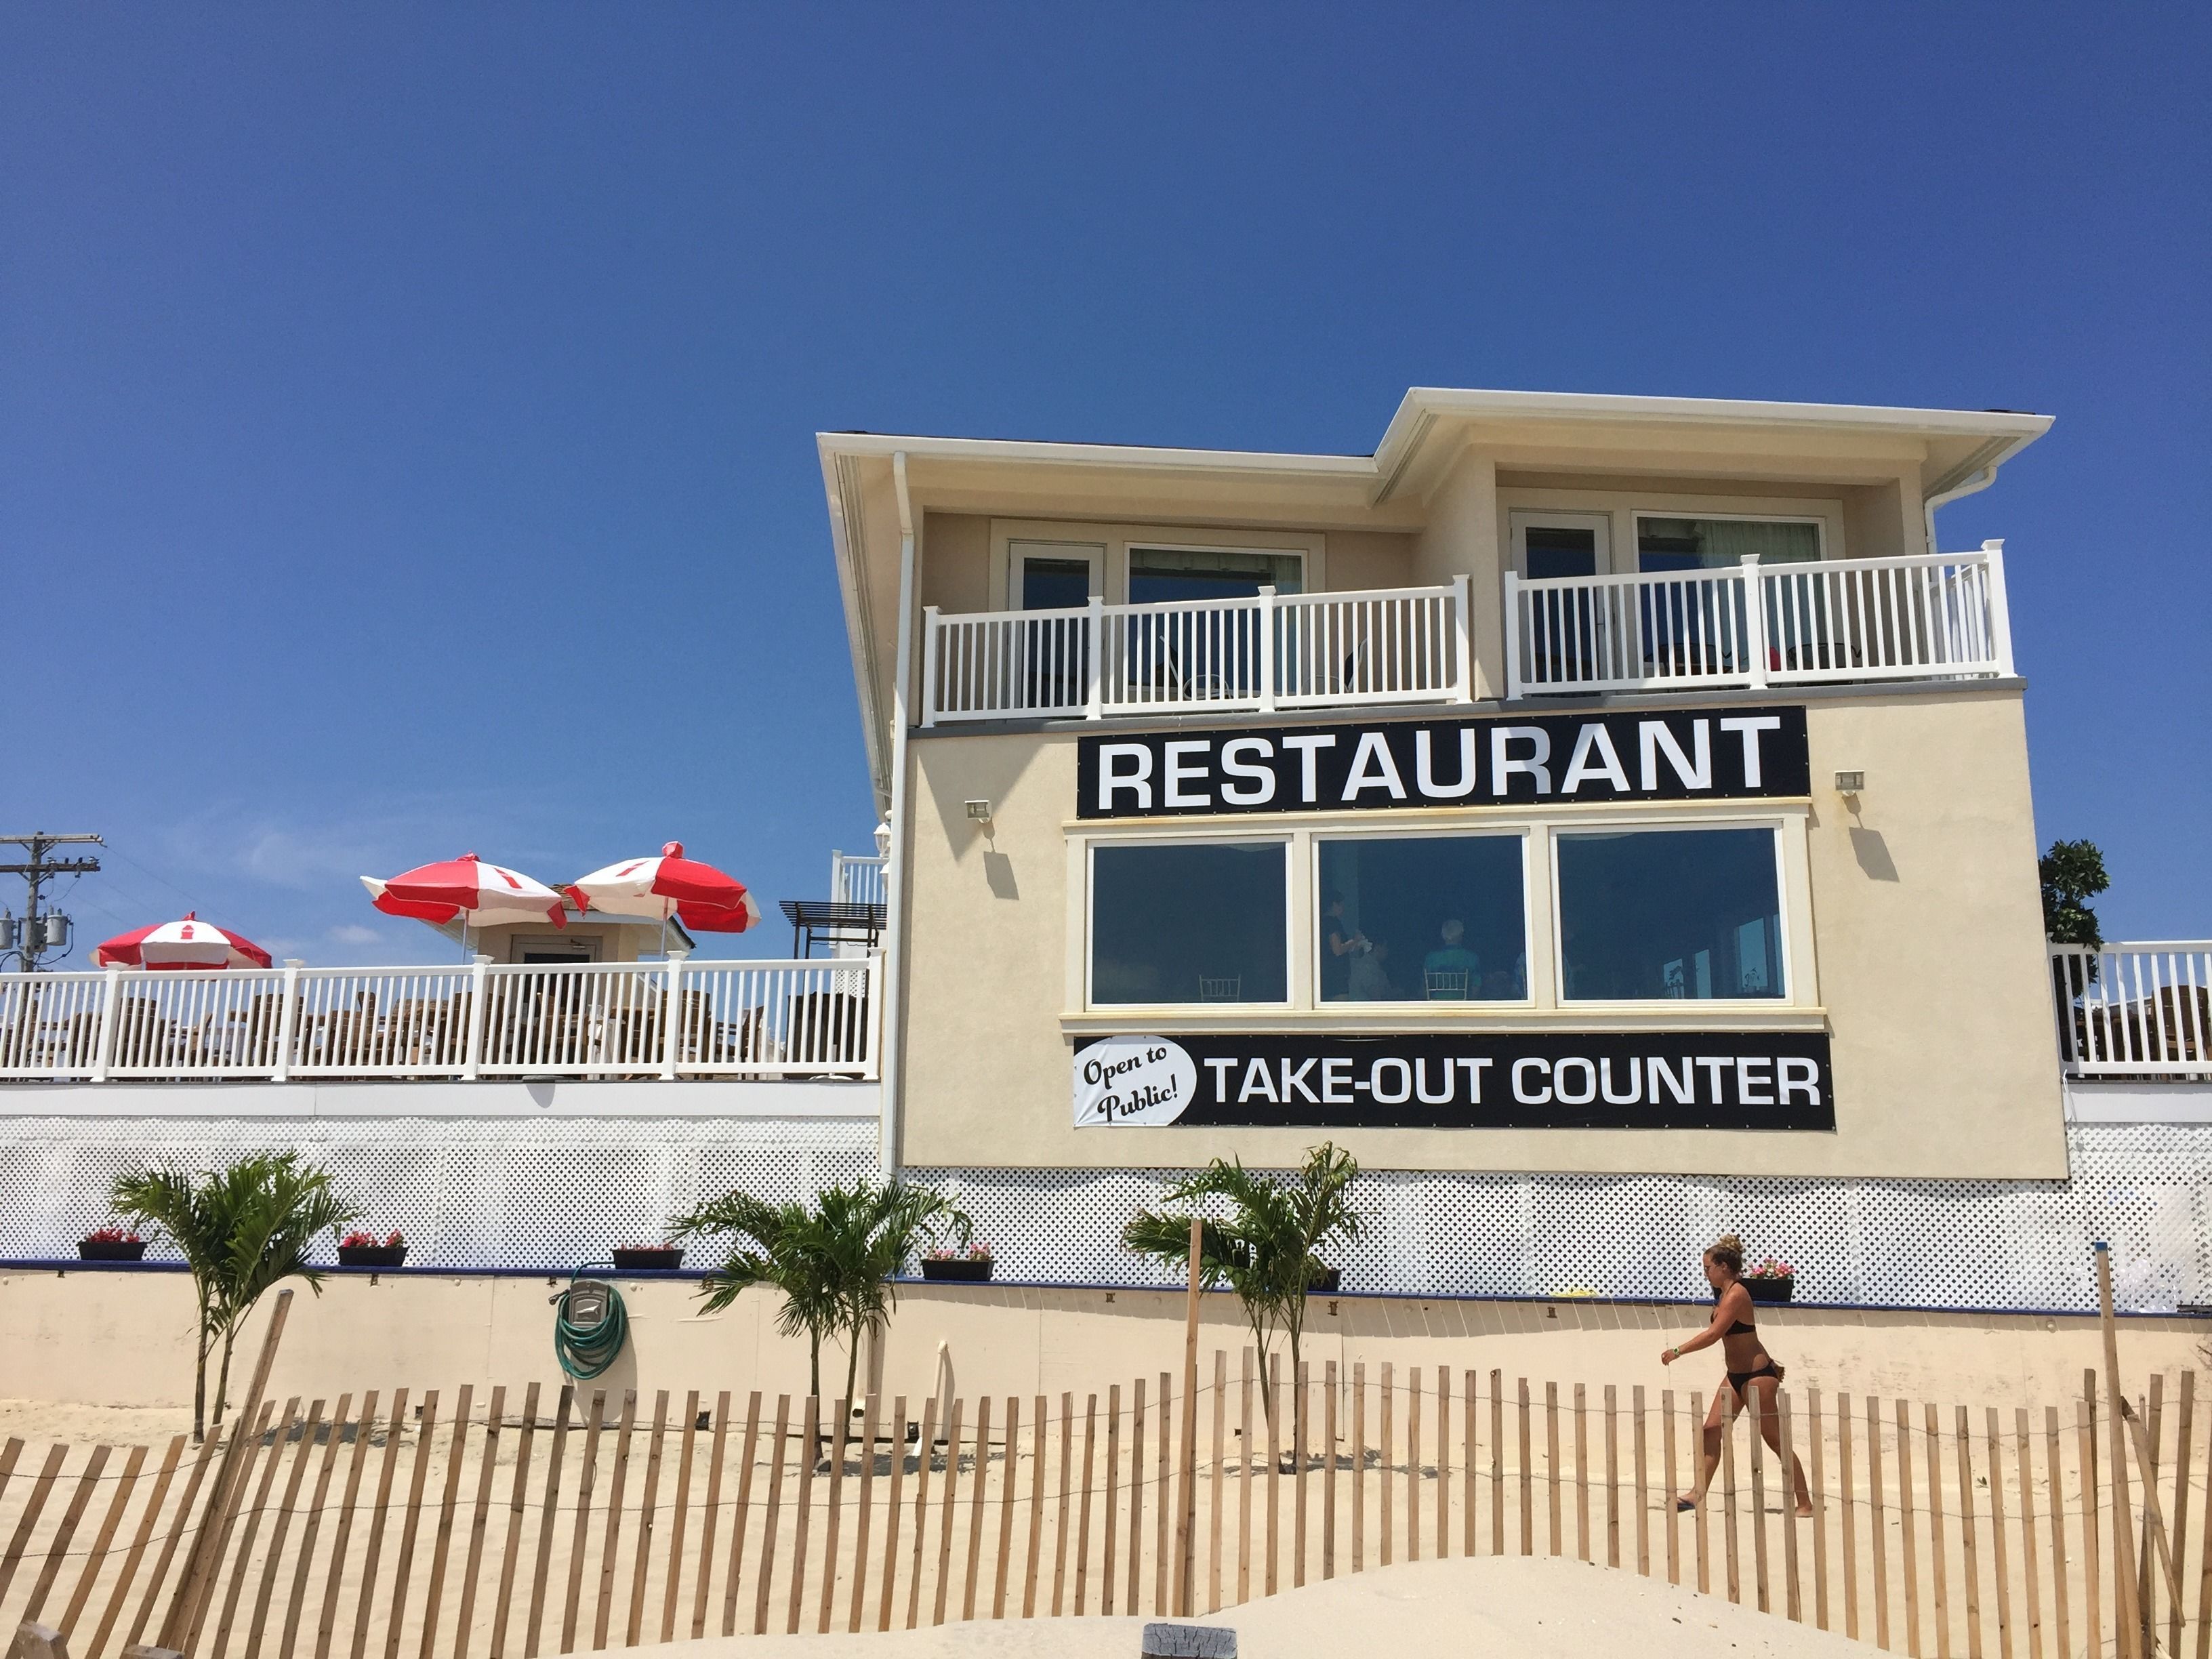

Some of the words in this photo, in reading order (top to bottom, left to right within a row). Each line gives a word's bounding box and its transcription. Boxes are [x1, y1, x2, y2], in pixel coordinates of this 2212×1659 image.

[1098, 715, 1781, 810] RESTAURANT
[1083, 1056, 1143, 1090] Open
[1146, 1047, 1167, 1063] to
[1204, 1057, 1493, 1104] TAKE-OUT
[1511, 1057, 1821, 1105] COUNTER
[1097, 1073, 1178, 1122] Public!
